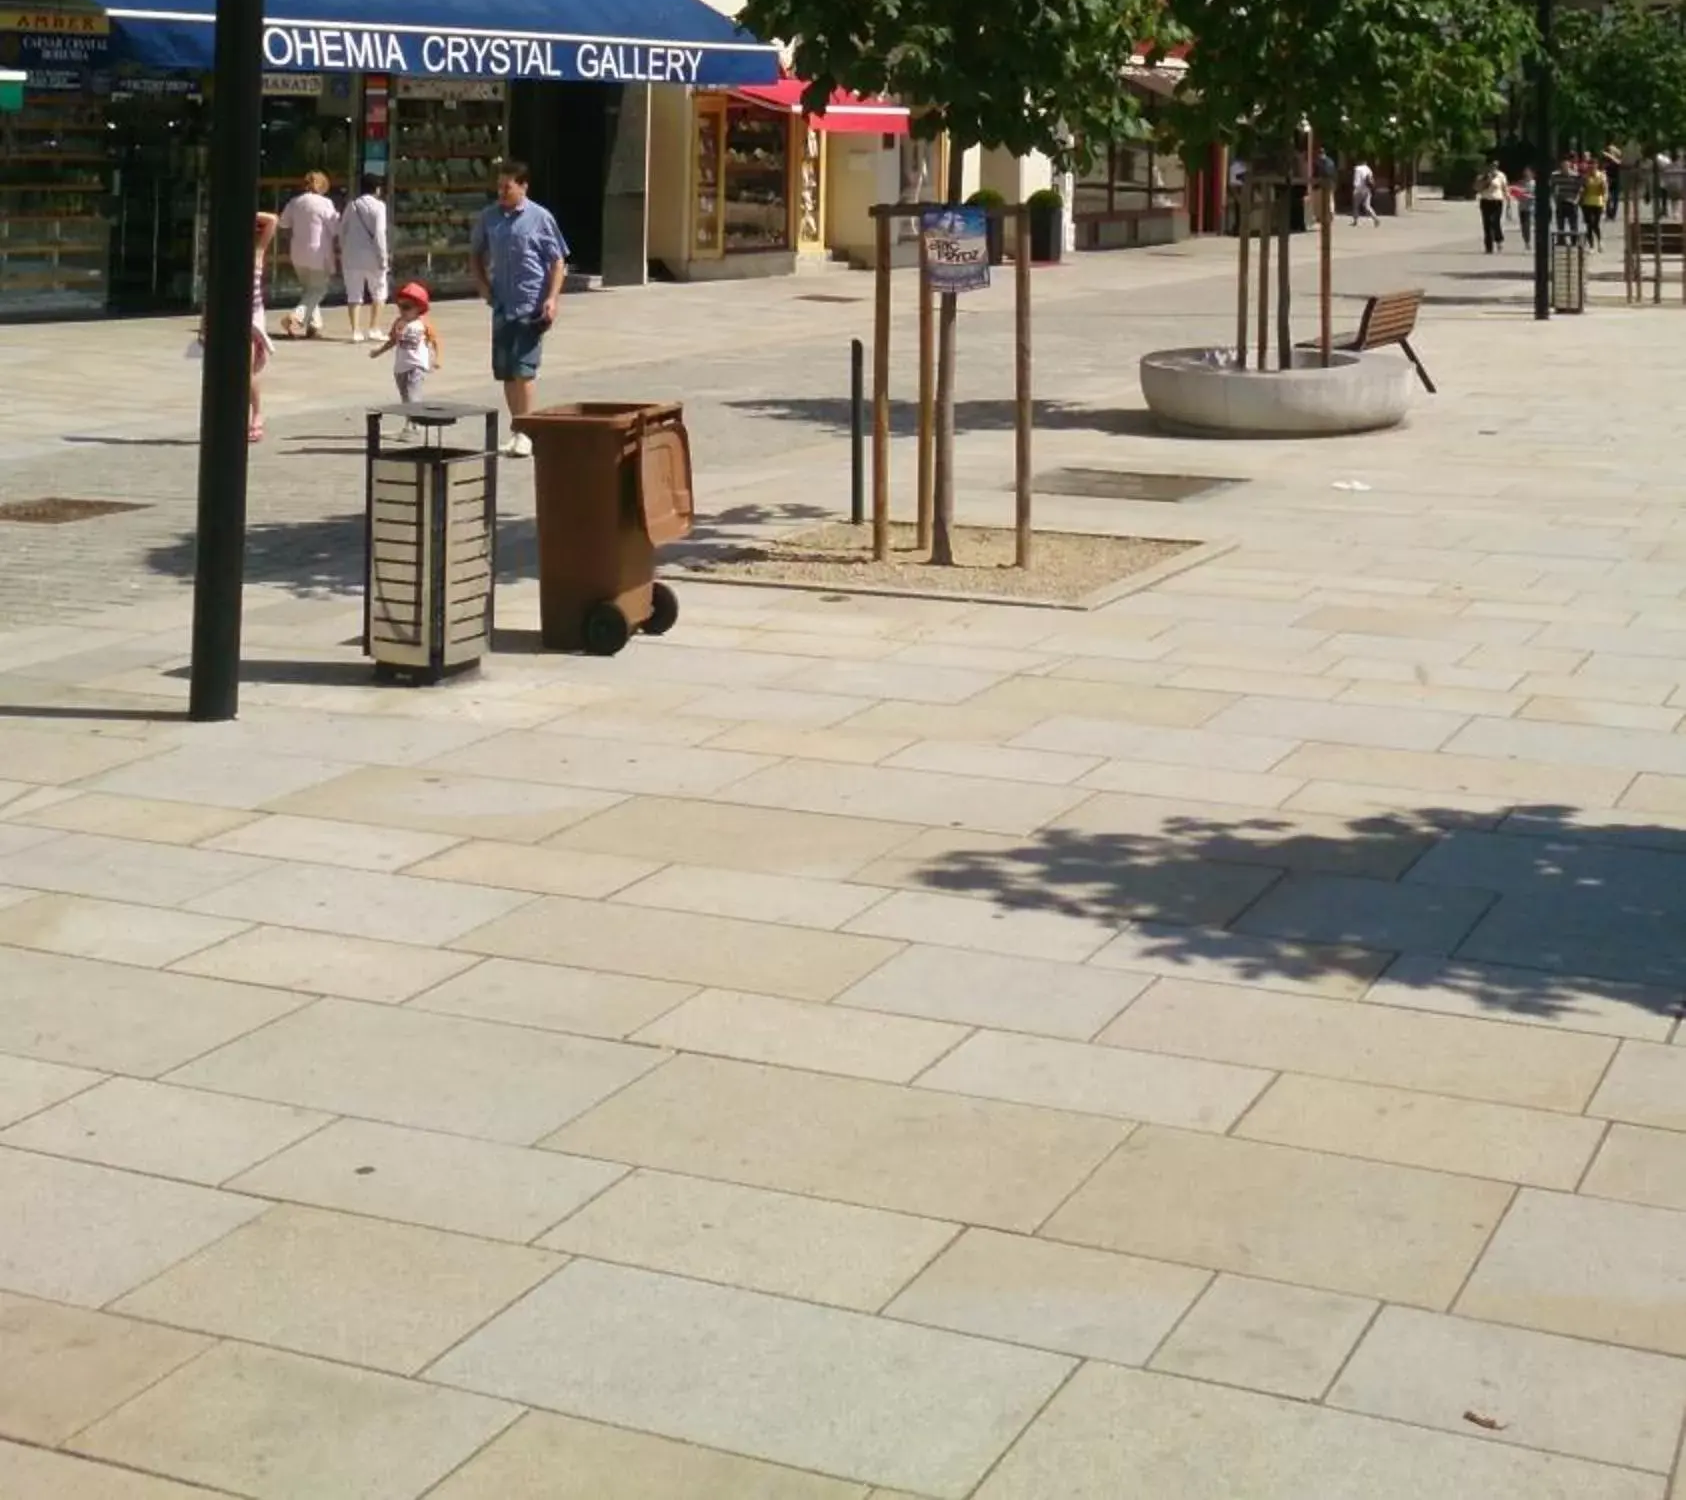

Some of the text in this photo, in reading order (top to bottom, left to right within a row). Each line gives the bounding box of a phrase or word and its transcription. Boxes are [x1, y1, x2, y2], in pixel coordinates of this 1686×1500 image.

[17, 13, 95, 31] AMBER
[262, 26, 703, 82] OHEMIA CRYSTAL GALLERY
